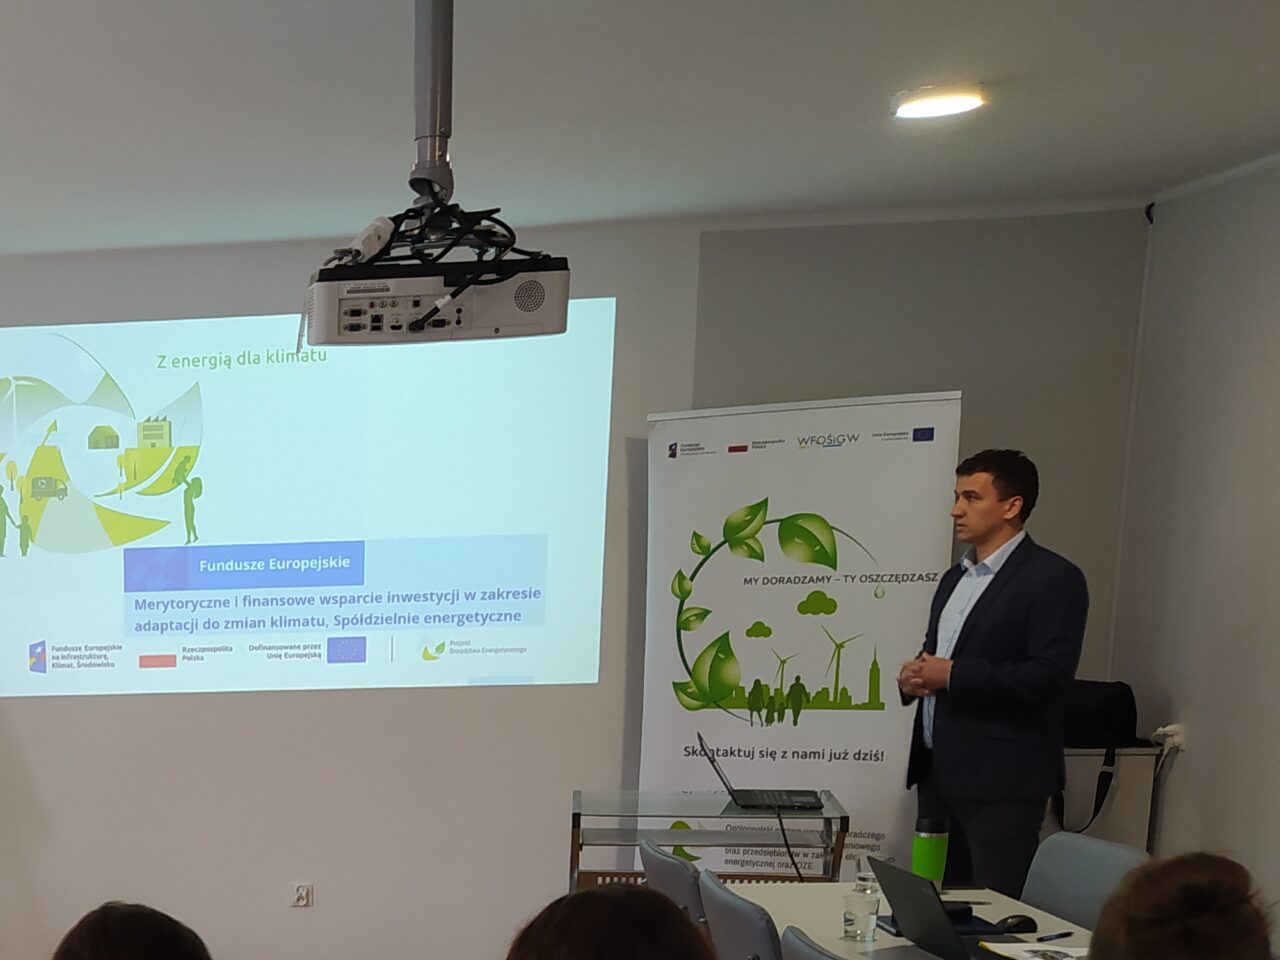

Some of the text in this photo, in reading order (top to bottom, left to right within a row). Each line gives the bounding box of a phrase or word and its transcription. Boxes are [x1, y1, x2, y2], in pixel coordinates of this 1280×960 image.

[156, 348, 328, 370] Z energią dla klimatu
[198, 555, 351, 573] Fundusze Europejskie
[743, 576, 759, 586] MY
[762, 575, 832, 585] DORADZAMY
[843, 574, 857, 584] TY
[859, 572, 938, 585] OSZCZĘDZASZ
[134, 586, 542, 615] Merytoryczne i finansowe wsparcie inwestycji w zakresie
[134, 609, 522, 635] adaptacji do zmian klimatu, Spółdzielnie energetyczne
[51, 643, 122, 653] Fundusze Europejskie
[182, 645, 233, 654] Rzeczpospolita
[249, 643, 322, 652] Dofinansowane przez
[267, 652, 282, 660] Unię
[76, 660, 115, 669] Środowisko
[683, 745, 884, 763] Skontaktuj się z nami już dziś!
